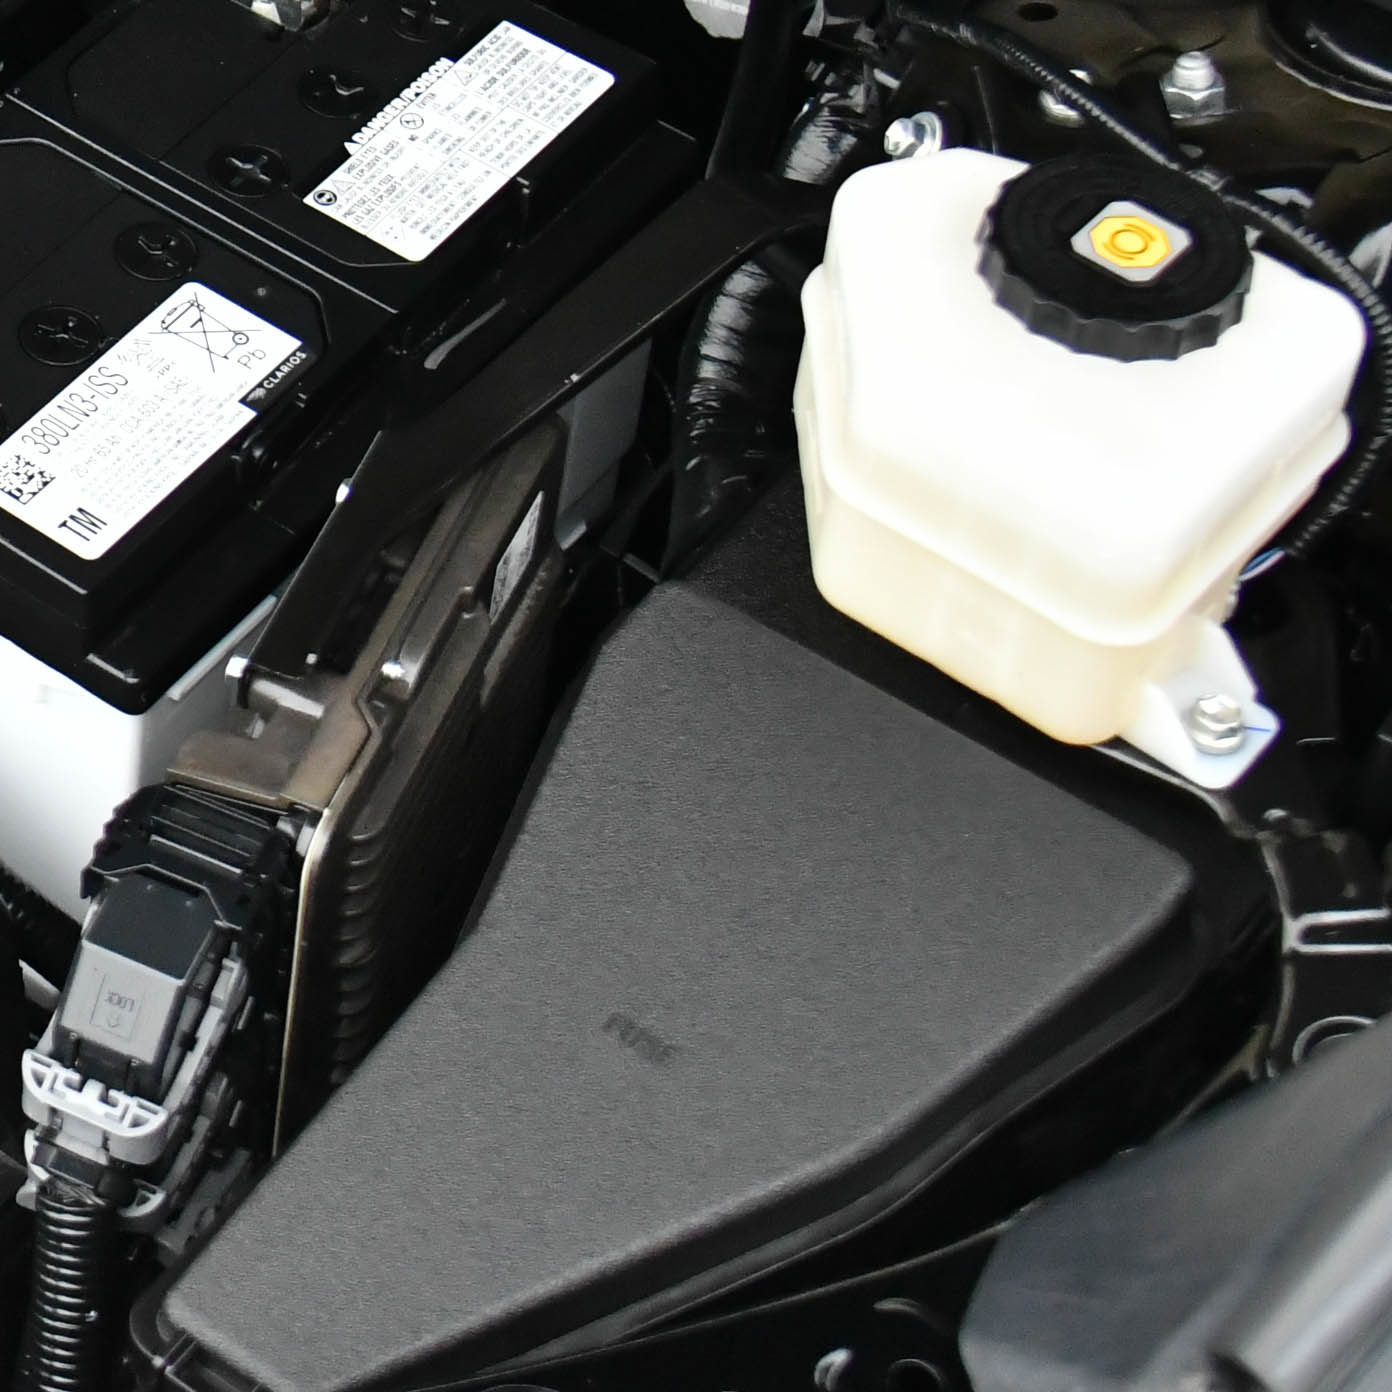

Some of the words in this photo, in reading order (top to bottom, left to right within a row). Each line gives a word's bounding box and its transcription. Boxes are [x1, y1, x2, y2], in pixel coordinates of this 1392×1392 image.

[351, 57, 455, 144] DANGER/POISON
[237, 349, 266, 370] Pb
[263, 351, 307, 389] CLARIOS
[21, 366, 128, 455] 380LN3-ISS
[58, 507, 107, 541] TM
